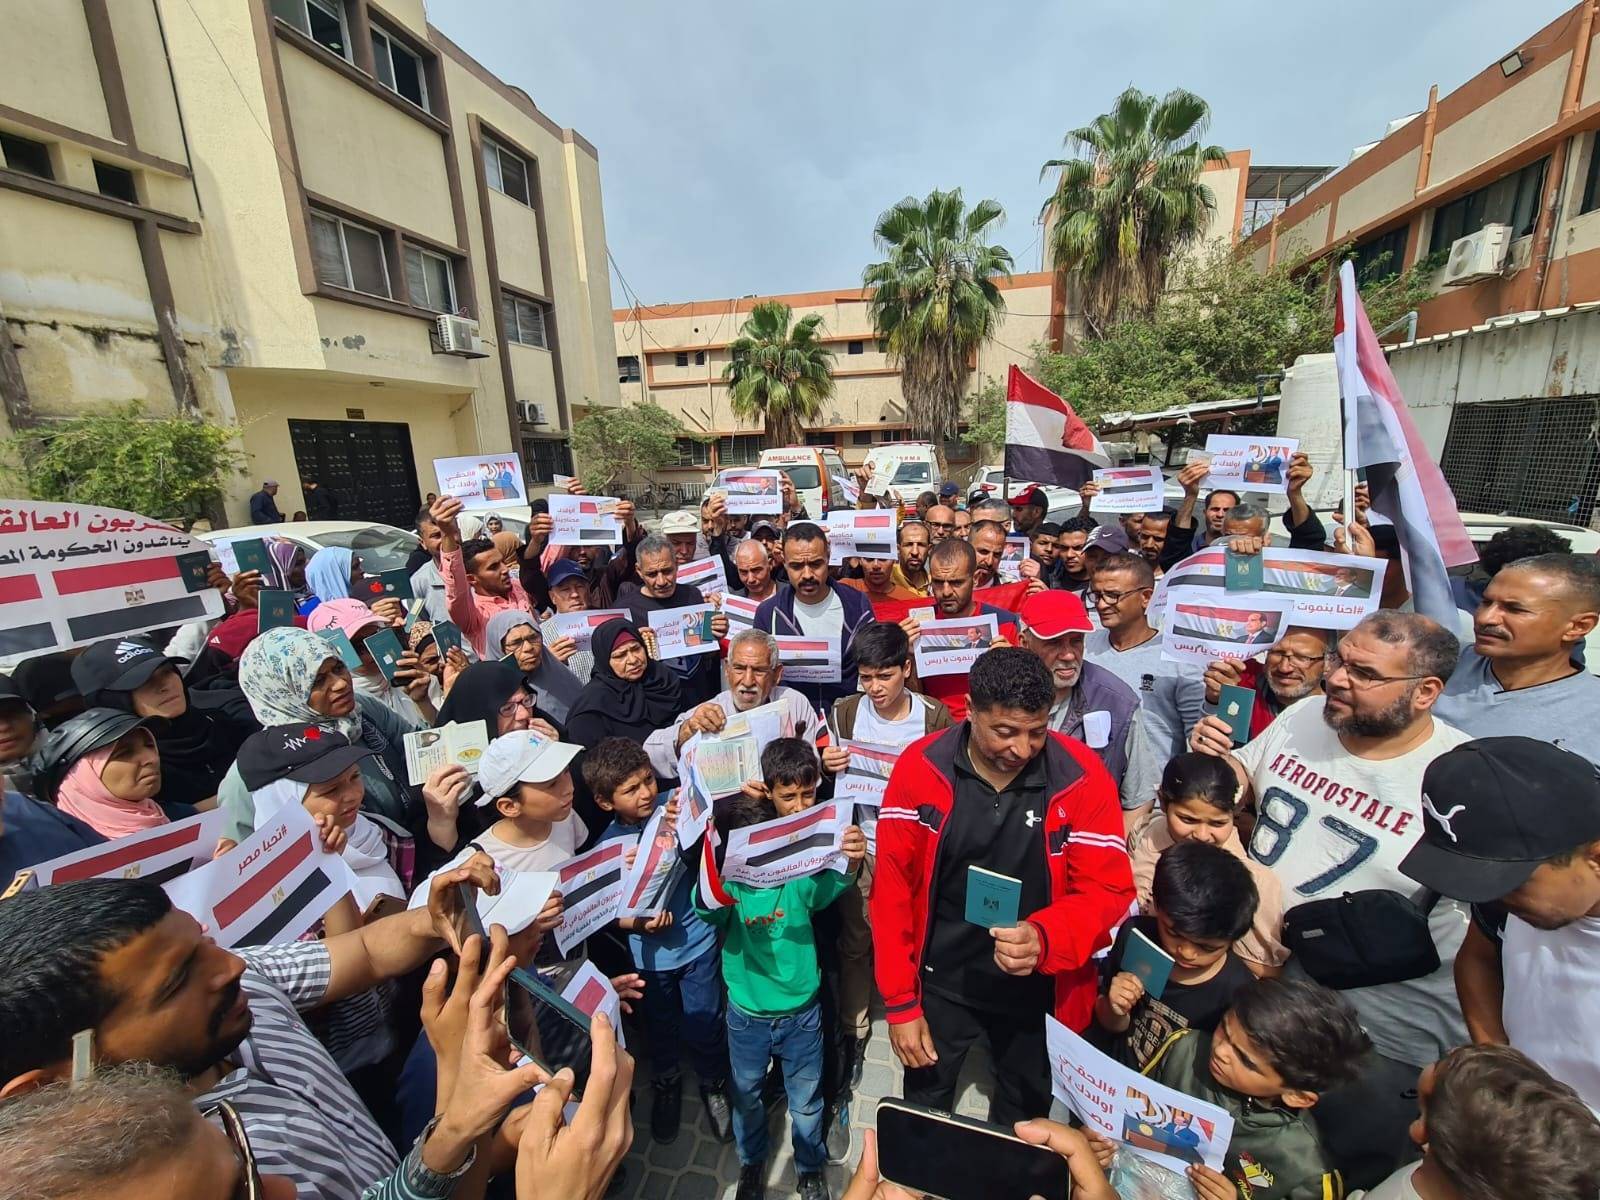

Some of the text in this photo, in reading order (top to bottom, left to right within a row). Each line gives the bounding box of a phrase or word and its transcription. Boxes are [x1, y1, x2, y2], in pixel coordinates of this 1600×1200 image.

[28, 539, 118, 562] الحكومة
[124, 536, 191, 554] يناشدون
[1297, 602, 1334, 614] بنموت
[118, 647, 153, 665] adidas
[237, 823, 288, 875] #تحيا مصر
[1249, 786, 1380, 897] 87
[1058, 1054, 1117, 1097] #الحقي
